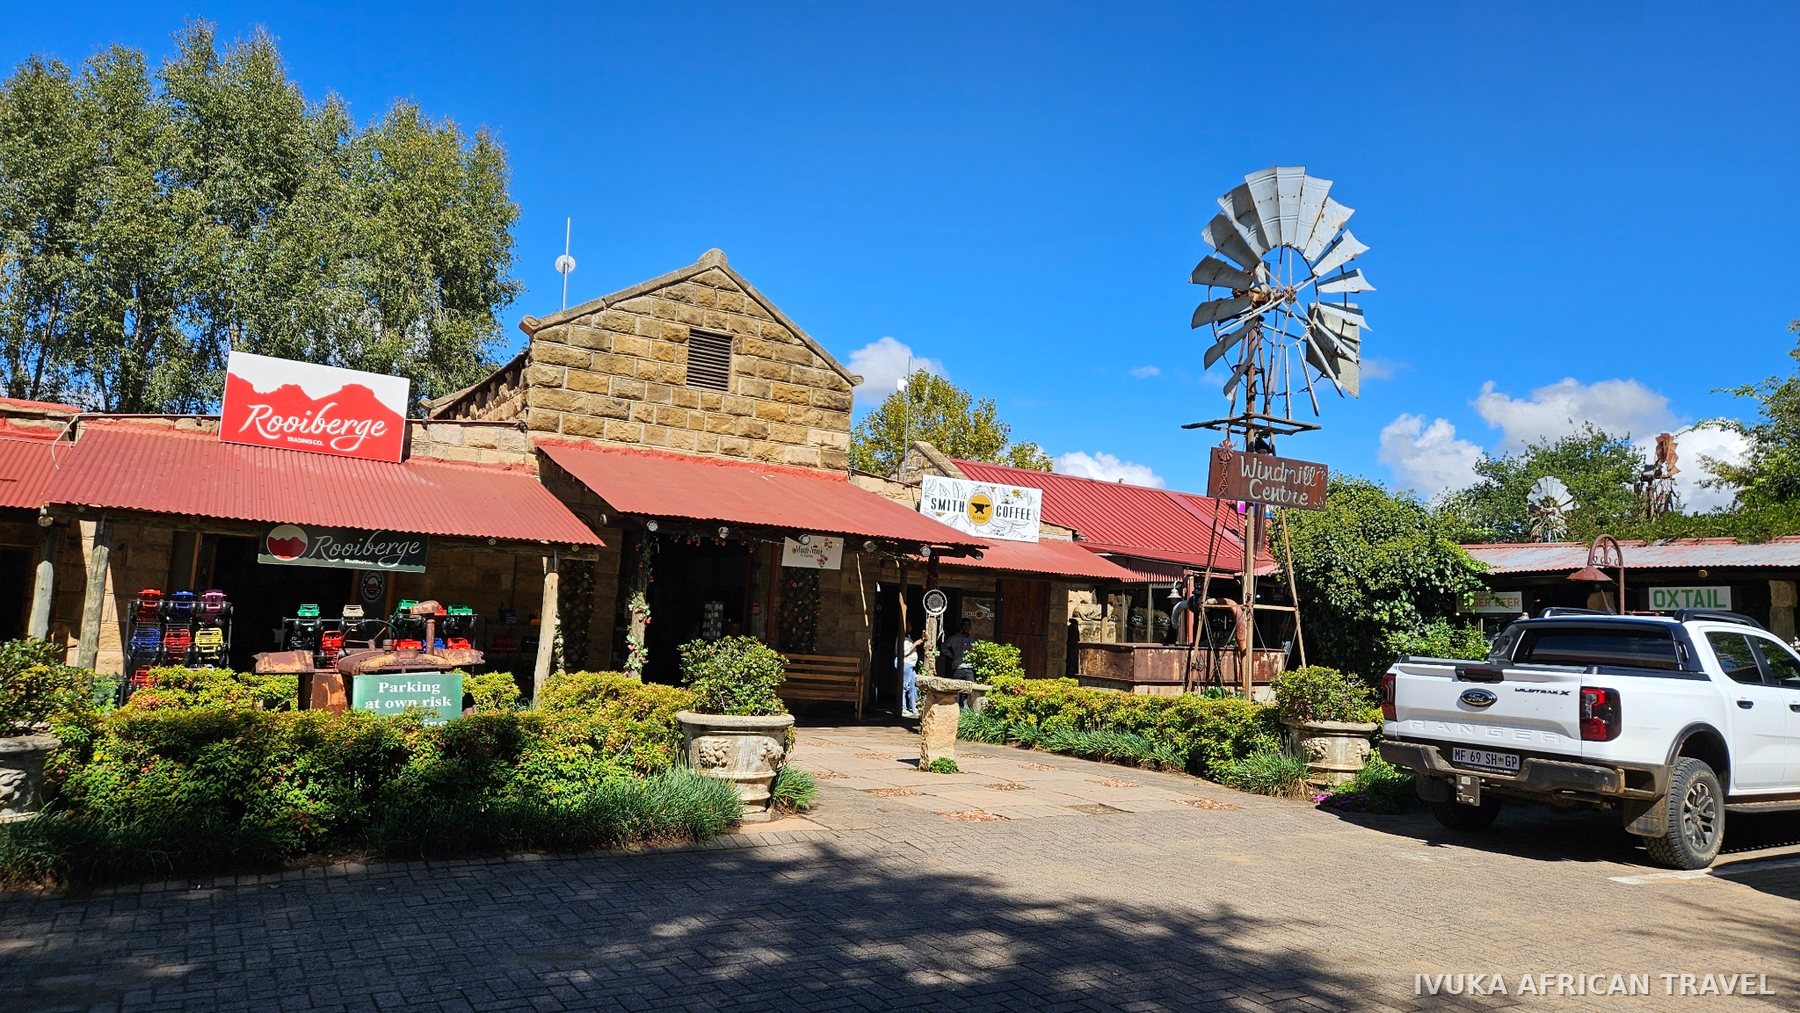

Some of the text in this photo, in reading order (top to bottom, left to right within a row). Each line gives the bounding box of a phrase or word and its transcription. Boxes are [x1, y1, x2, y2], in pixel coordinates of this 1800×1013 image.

[238, 402, 388, 452] Rooiberge
[287, 436, 312, 445] TRADING
[1240, 456, 1317, 487] Windmill
[1249, 479, 1309, 506] Centre
[930, 497, 1031, 521] SMITH COFFEE
[308, 530, 422, 568] Rooiberge
[1652, 589, 1727, 608] OXTAIL
[378, 681, 441, 695] Parking
[365, 696, 452, 709] at own risk
[1409, 719, 1562, 745] RANGER
[1454, 748, 1518, 768] MF 69 SH GP
